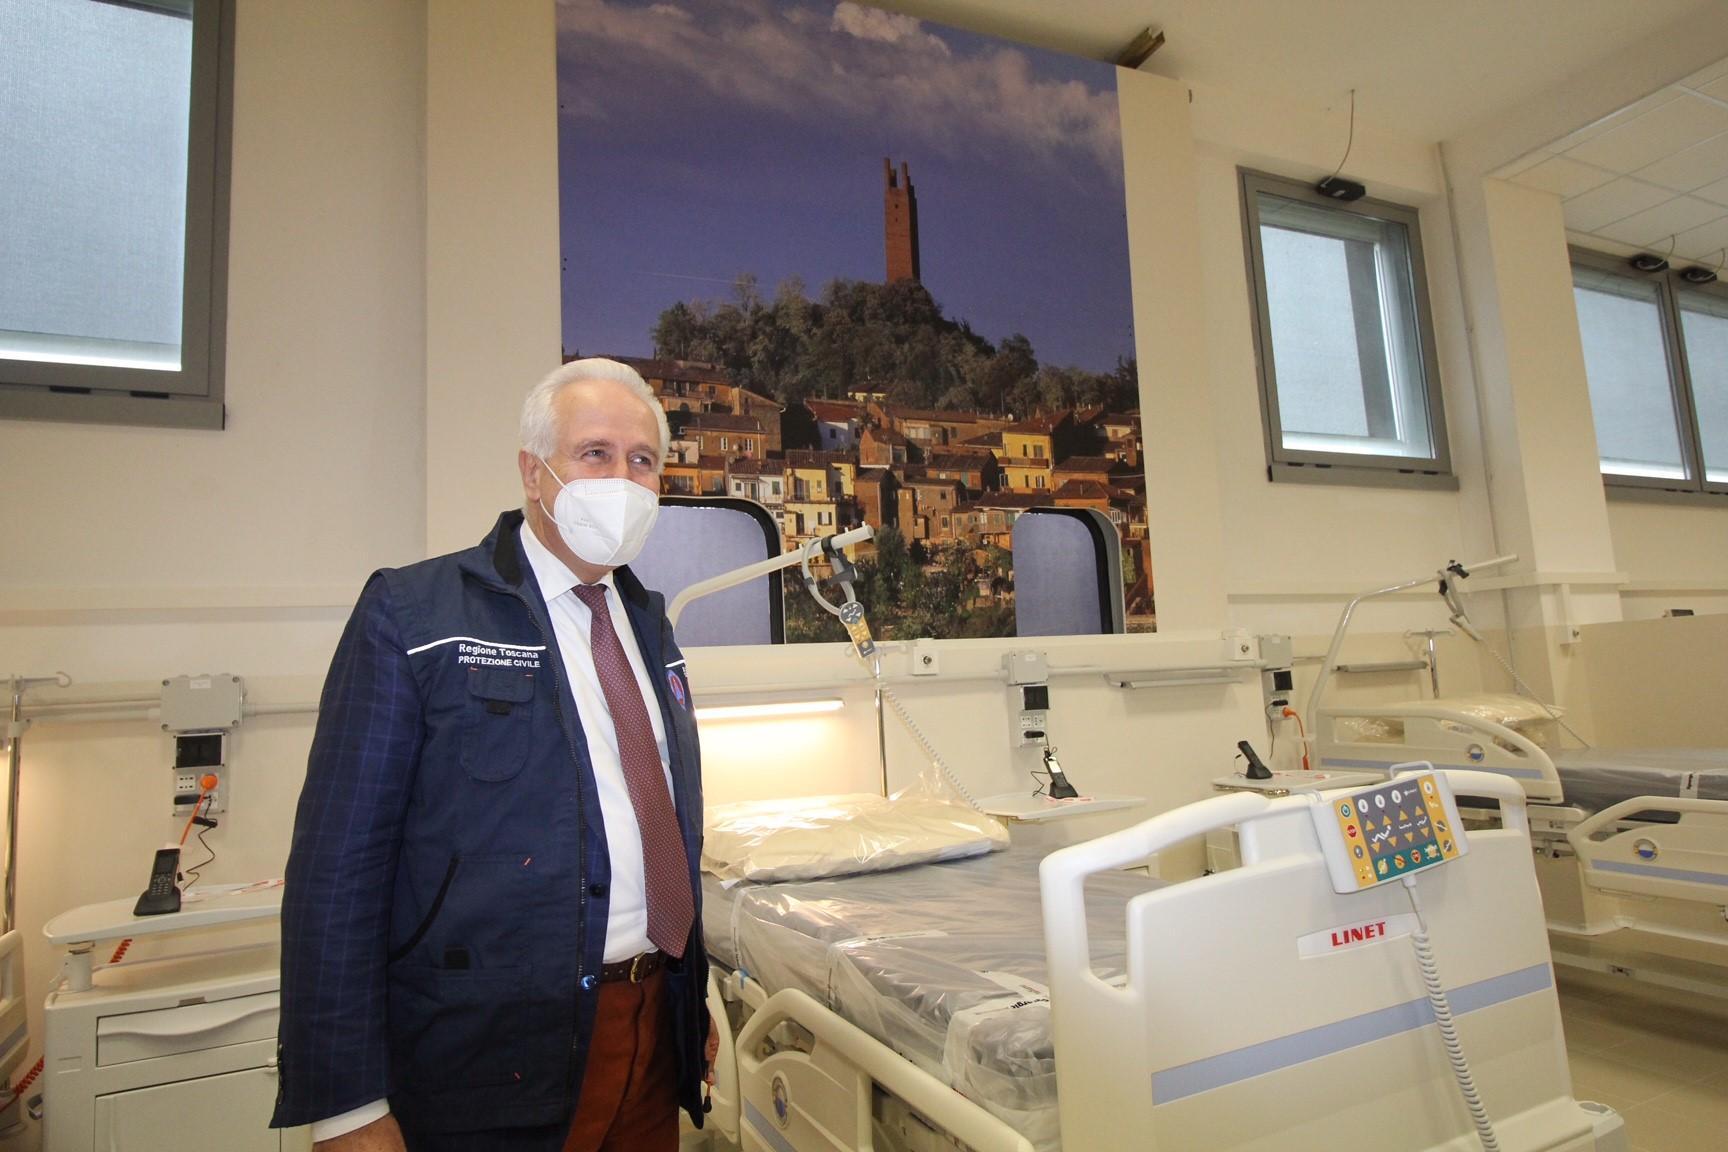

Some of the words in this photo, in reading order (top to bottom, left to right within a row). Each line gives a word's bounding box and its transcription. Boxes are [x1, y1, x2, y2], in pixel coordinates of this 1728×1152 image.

[458, 643, 497, 656] Regione
[499, 648, 539, 659] Toscana
[458, 655, 513, 666] PROTEZIONE
[513, 659, 541, 668] CIVILE
[1331, 921, 1386, 947] LINET
